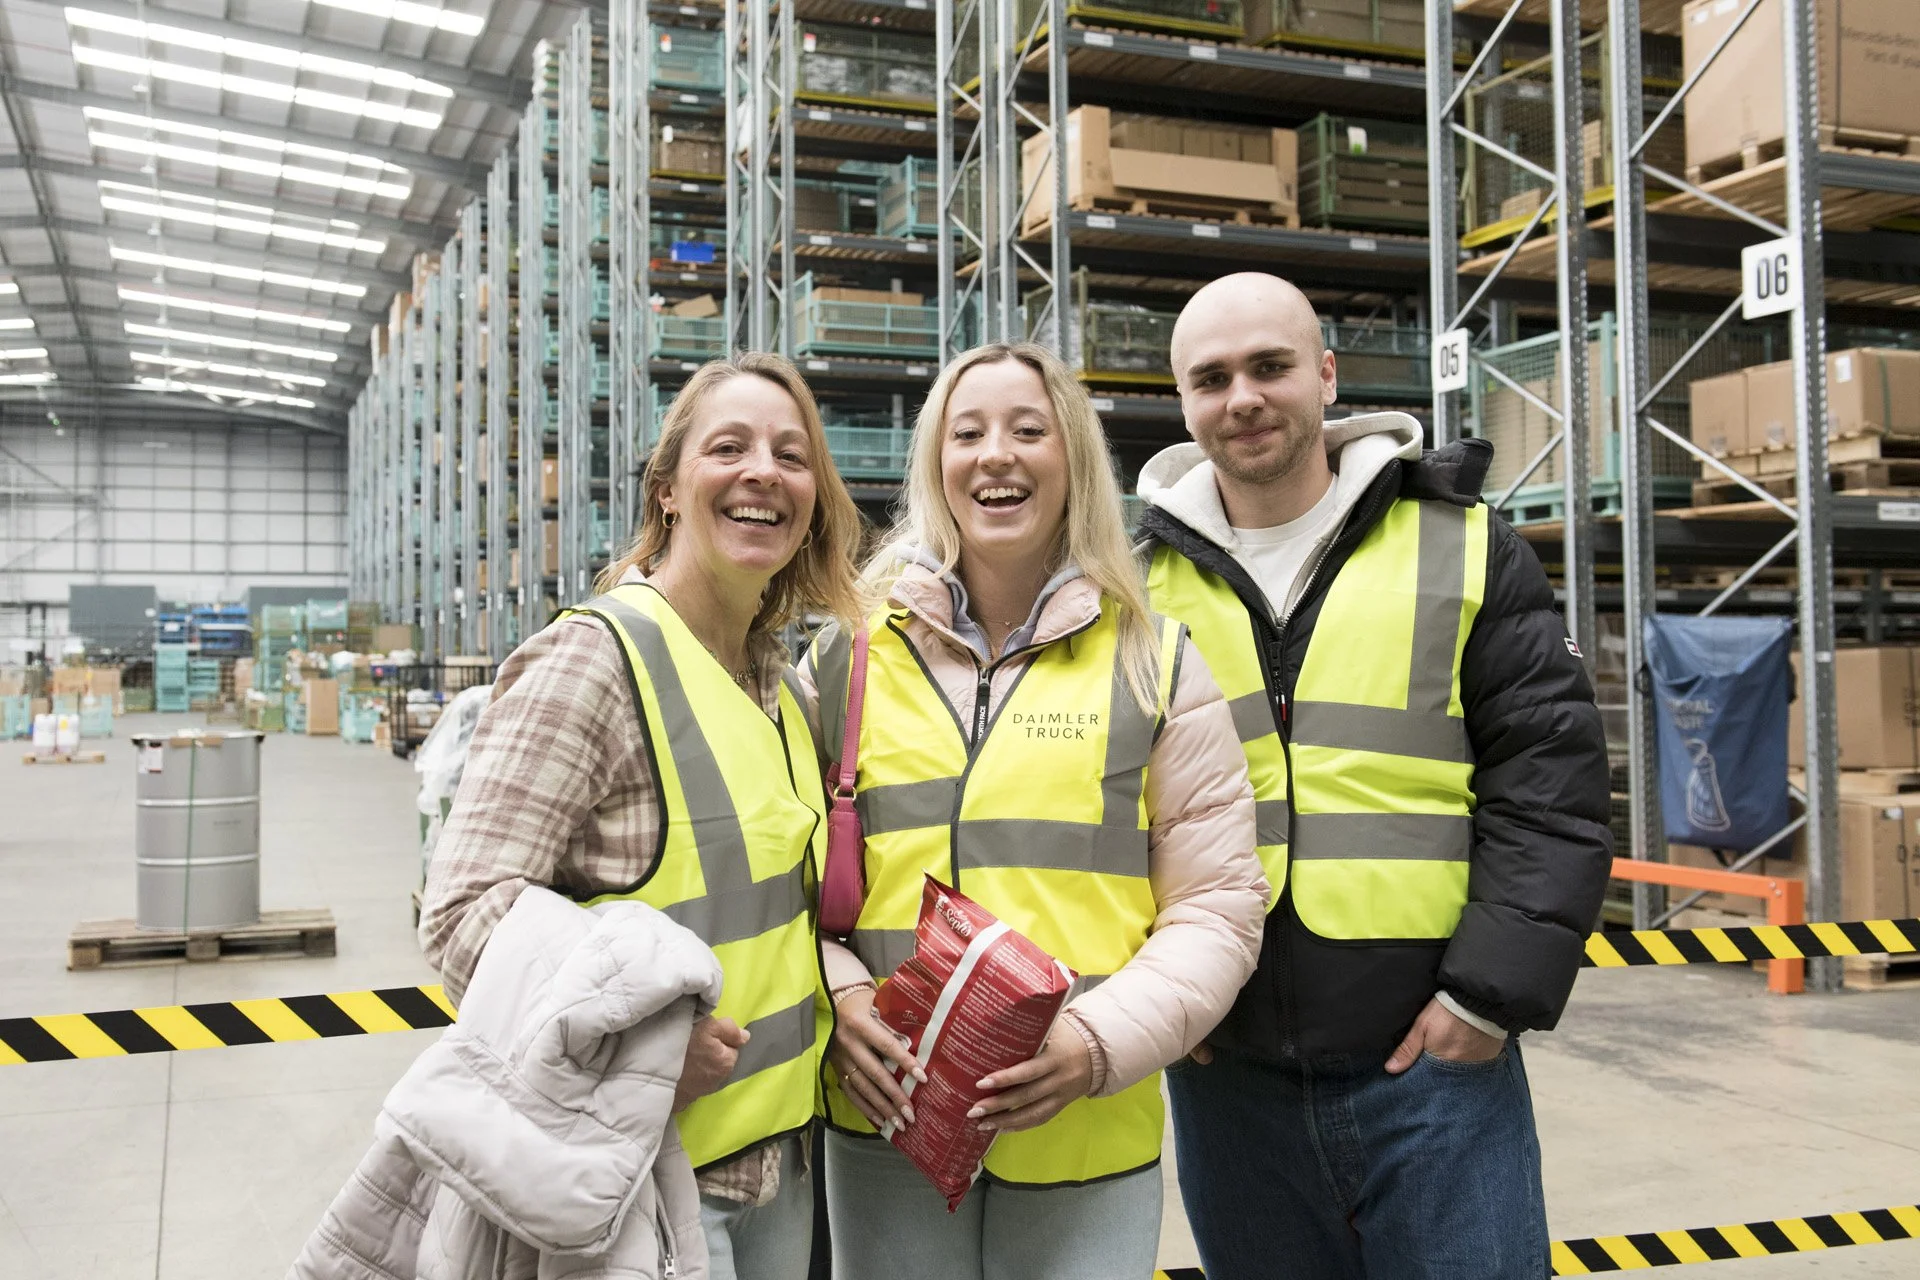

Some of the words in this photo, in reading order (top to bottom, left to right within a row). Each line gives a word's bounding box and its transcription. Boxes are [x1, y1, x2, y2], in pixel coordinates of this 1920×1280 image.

[1757, 253, 1788, 300] 06
[1440, 343, 1459, 378] 05
[1013, 713, 1099, 725] DAIMLER
[1025, 727, 1084, 740] TRUCK
